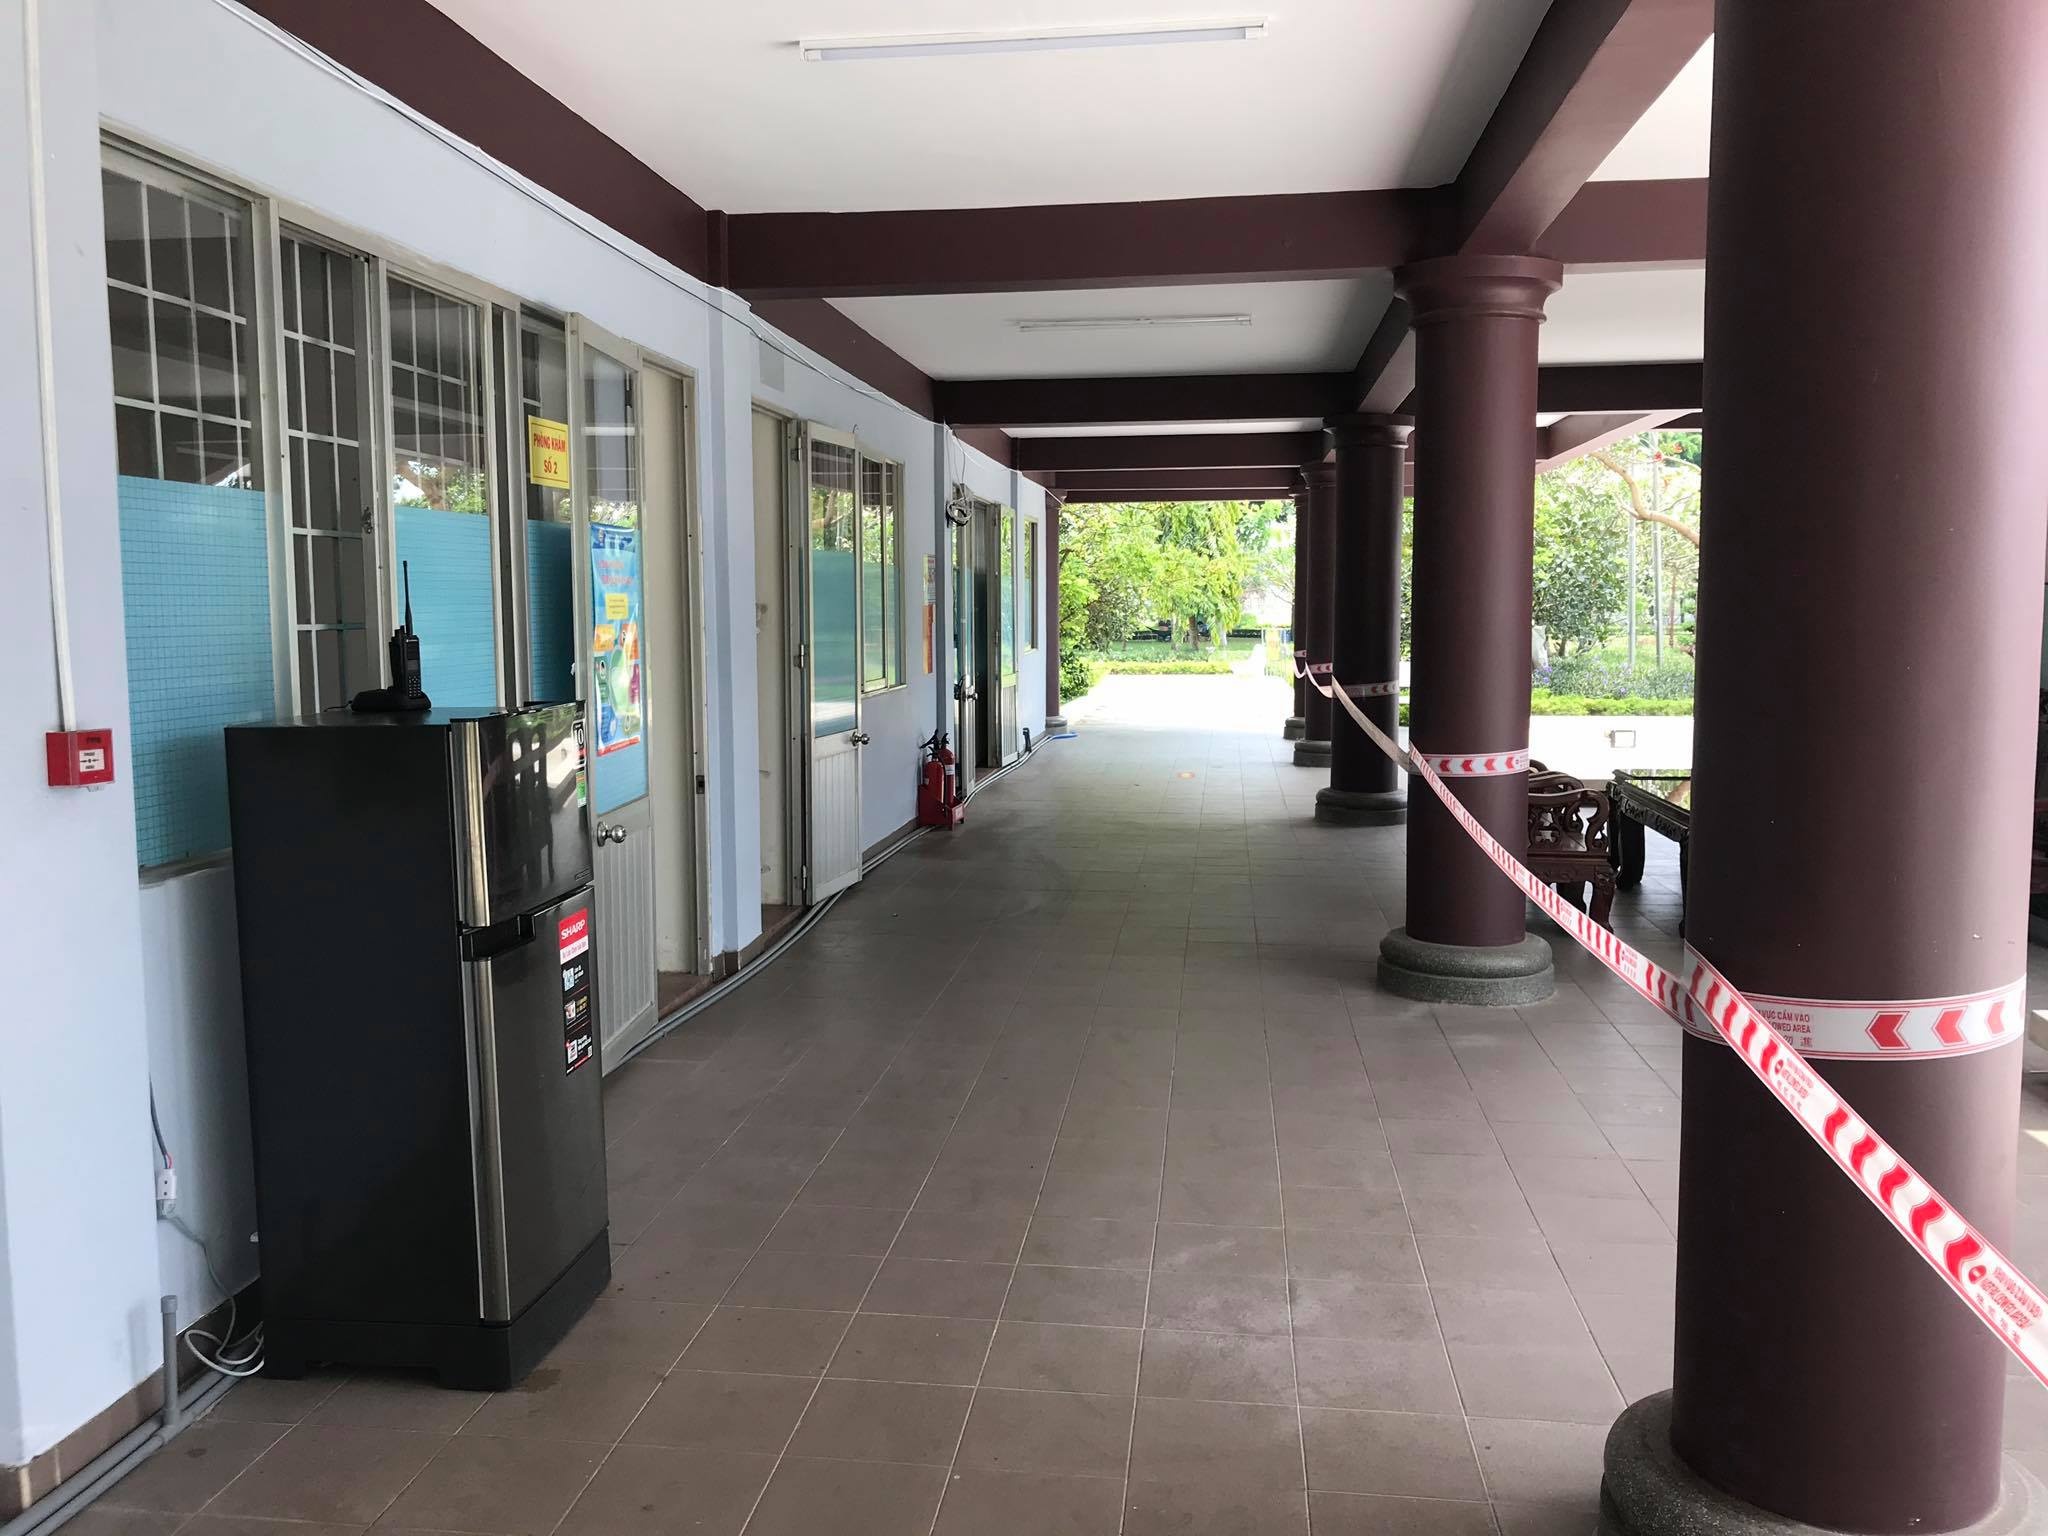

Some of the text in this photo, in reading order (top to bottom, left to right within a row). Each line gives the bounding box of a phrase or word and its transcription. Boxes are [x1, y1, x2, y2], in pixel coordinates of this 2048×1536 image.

[544, 456, 558, 474] SỐ 2
[561, 919, 586, 940] SHARP
[1793, 1024, 1811, 1033] AREA
